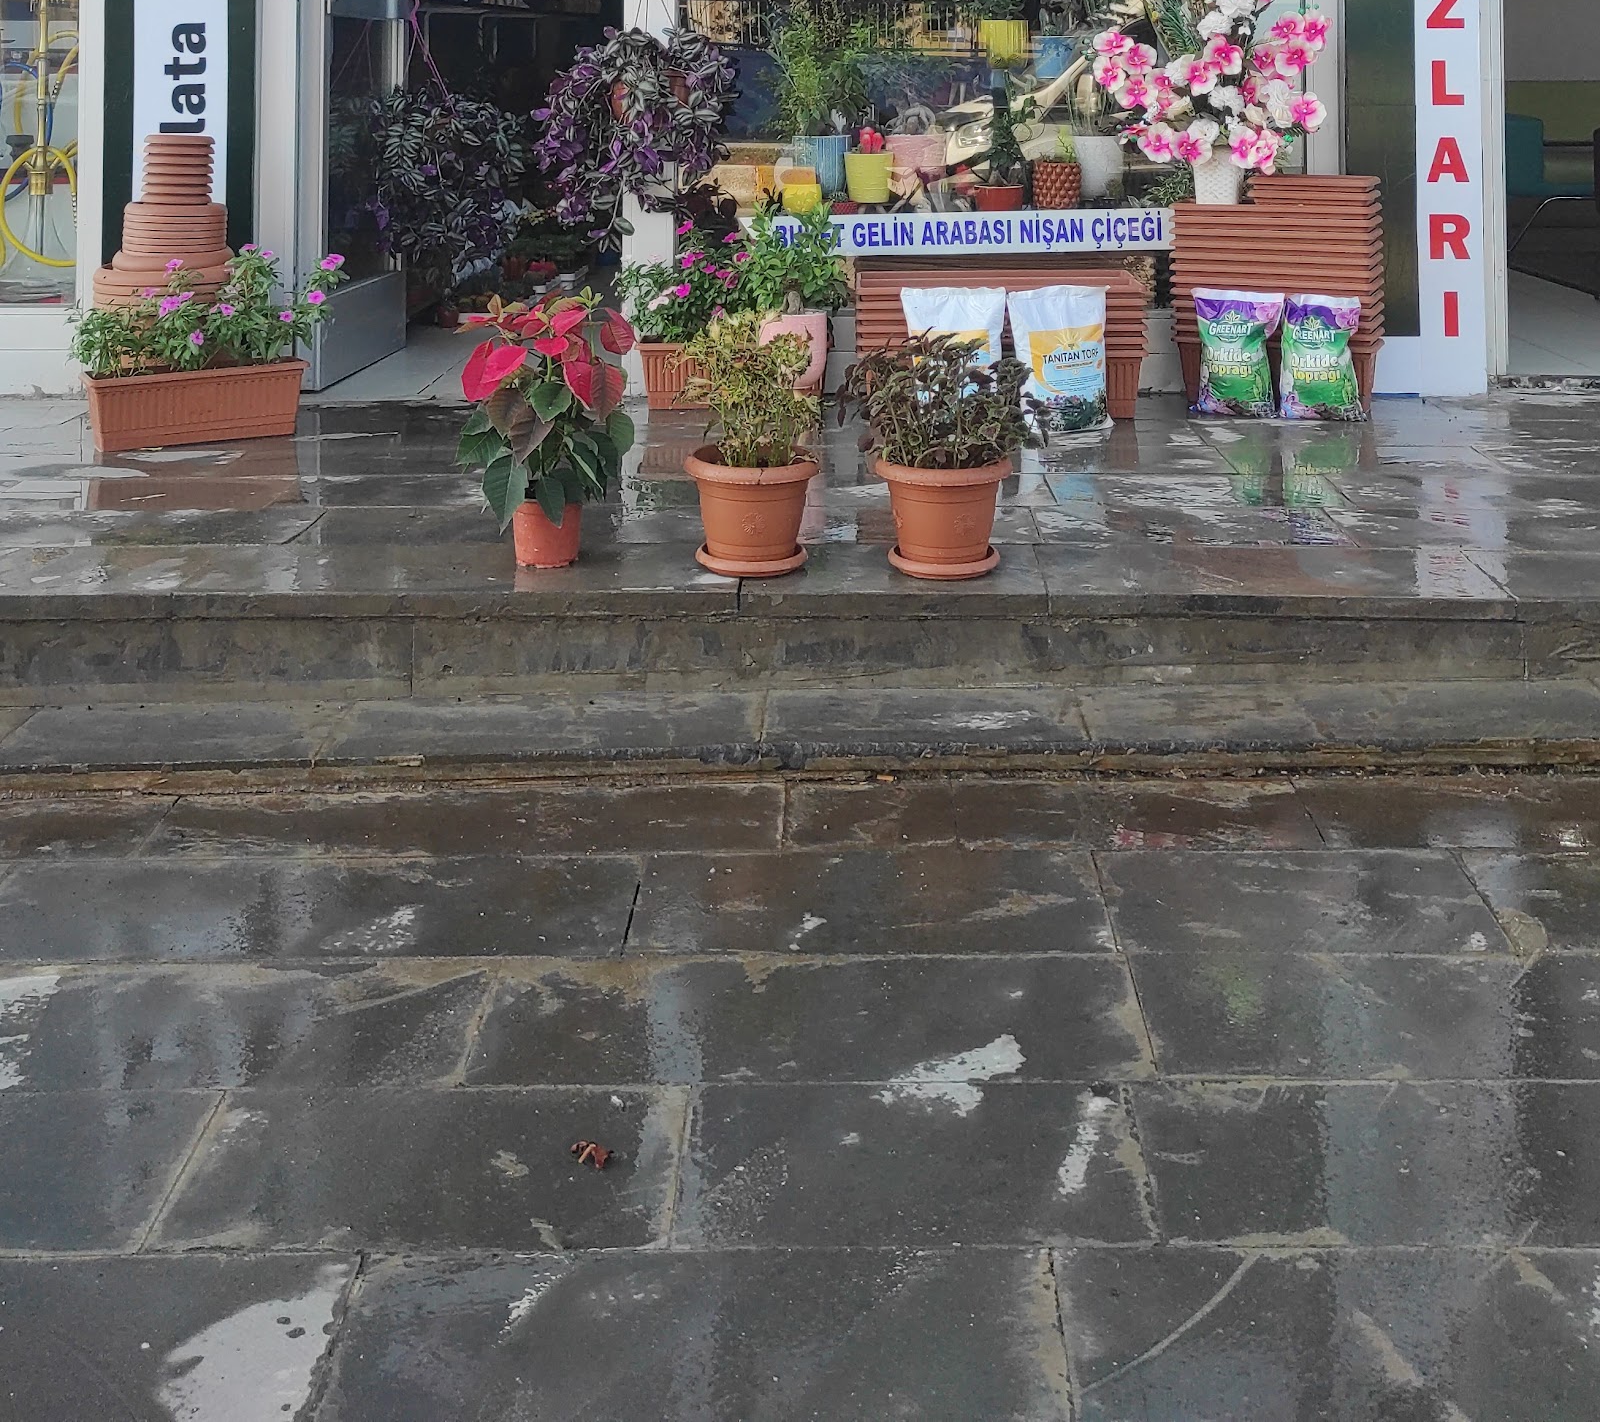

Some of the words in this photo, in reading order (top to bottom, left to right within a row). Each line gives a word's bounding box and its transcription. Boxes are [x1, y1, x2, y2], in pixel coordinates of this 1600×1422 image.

[159, 22, 207, 134] lata
[852, 216, 914, 247] GELİN
[921, 218, 1012, 246] ARABASI
[1019, 213, 1084, 250] NİŞAN
[1092, 211, 1163, 249] ÇİÇEĞİ
[1208, 322, 1254, 336] GREENART
[1206, 346, 1251, 362] Orkide
[1291, 353, 1339, 368] Orkide
